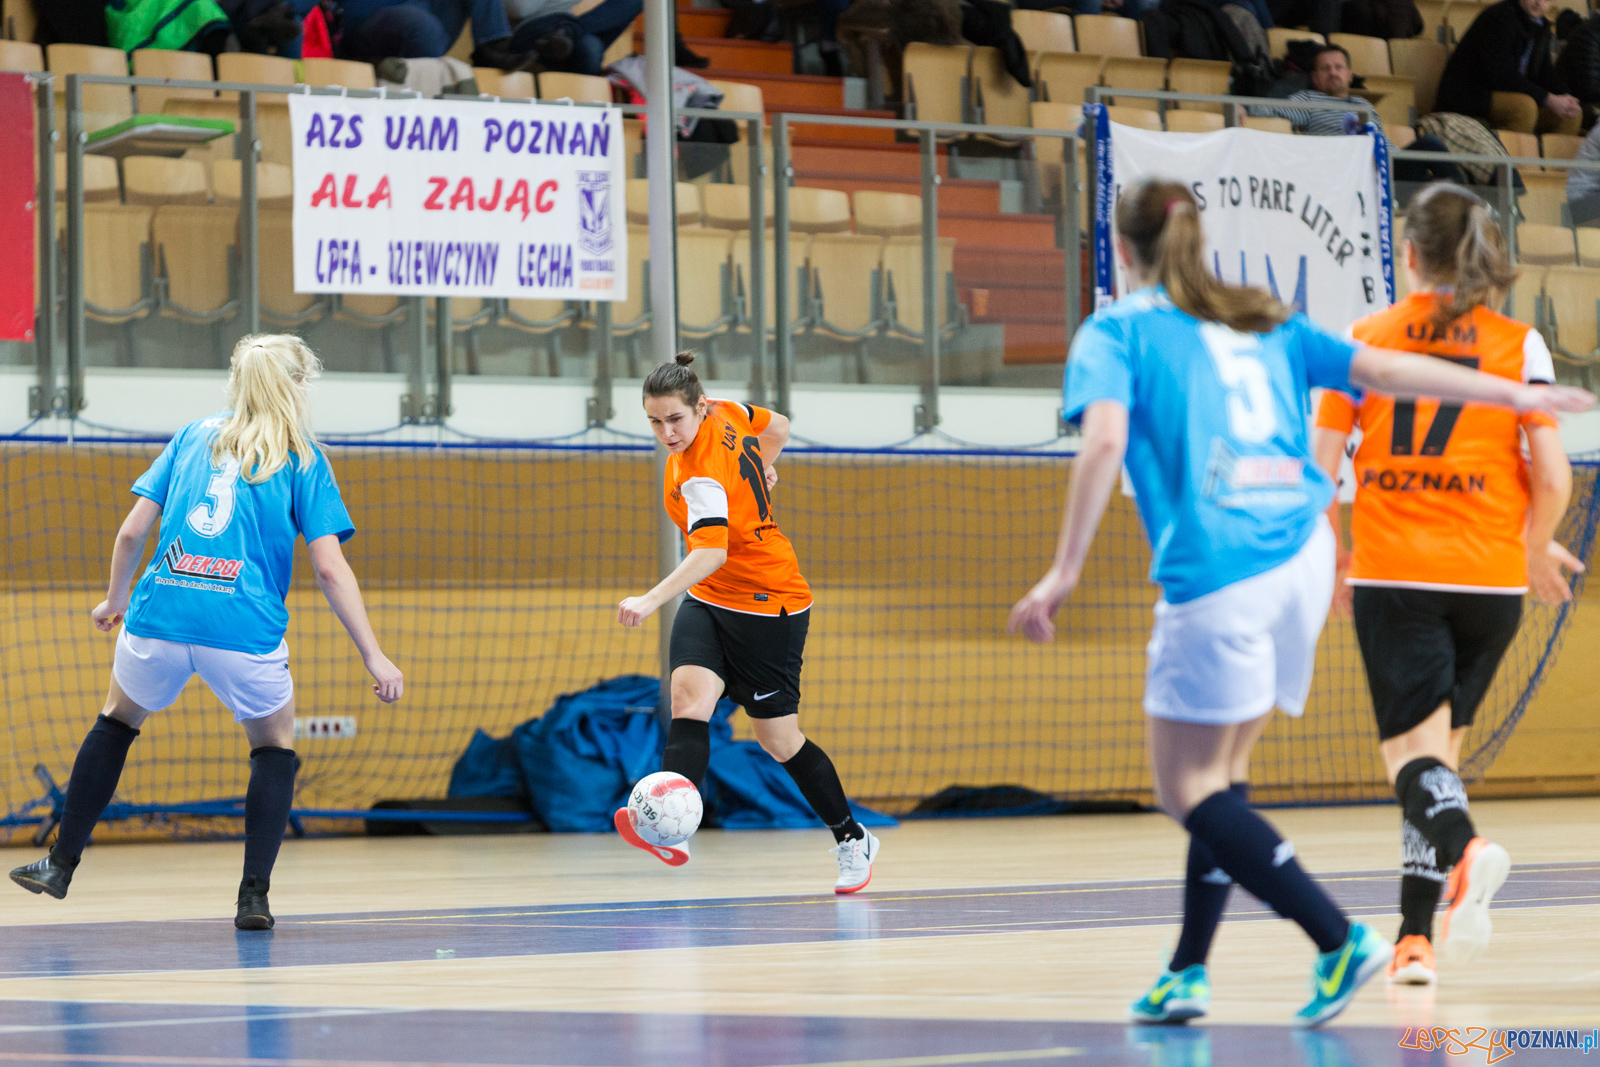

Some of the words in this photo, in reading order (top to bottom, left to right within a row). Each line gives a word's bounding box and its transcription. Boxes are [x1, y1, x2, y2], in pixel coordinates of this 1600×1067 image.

[306, 112, 364, 149] AZS
[386, 115, 459, 151] UAM
[484, 111, 611, 157] POZNAŃ
[310, 173, 392, 209] ALA
[423, 176, 559, 222] ZAJĄC
[1218, 176, 1242, 208] TO
[1249, 175, 1296, 214] PARE
[1300, 194, 1355, 268] LITER
[316, 239, 362, 286] LPFA
[518, 243, 574, 288] LECHA
[1407, 323, 1477, 344] UAM
[1202, 320, 1277, 444] 5
[1391, 354, 1480, 457] 17
[186, 448, 241, 539] 3
